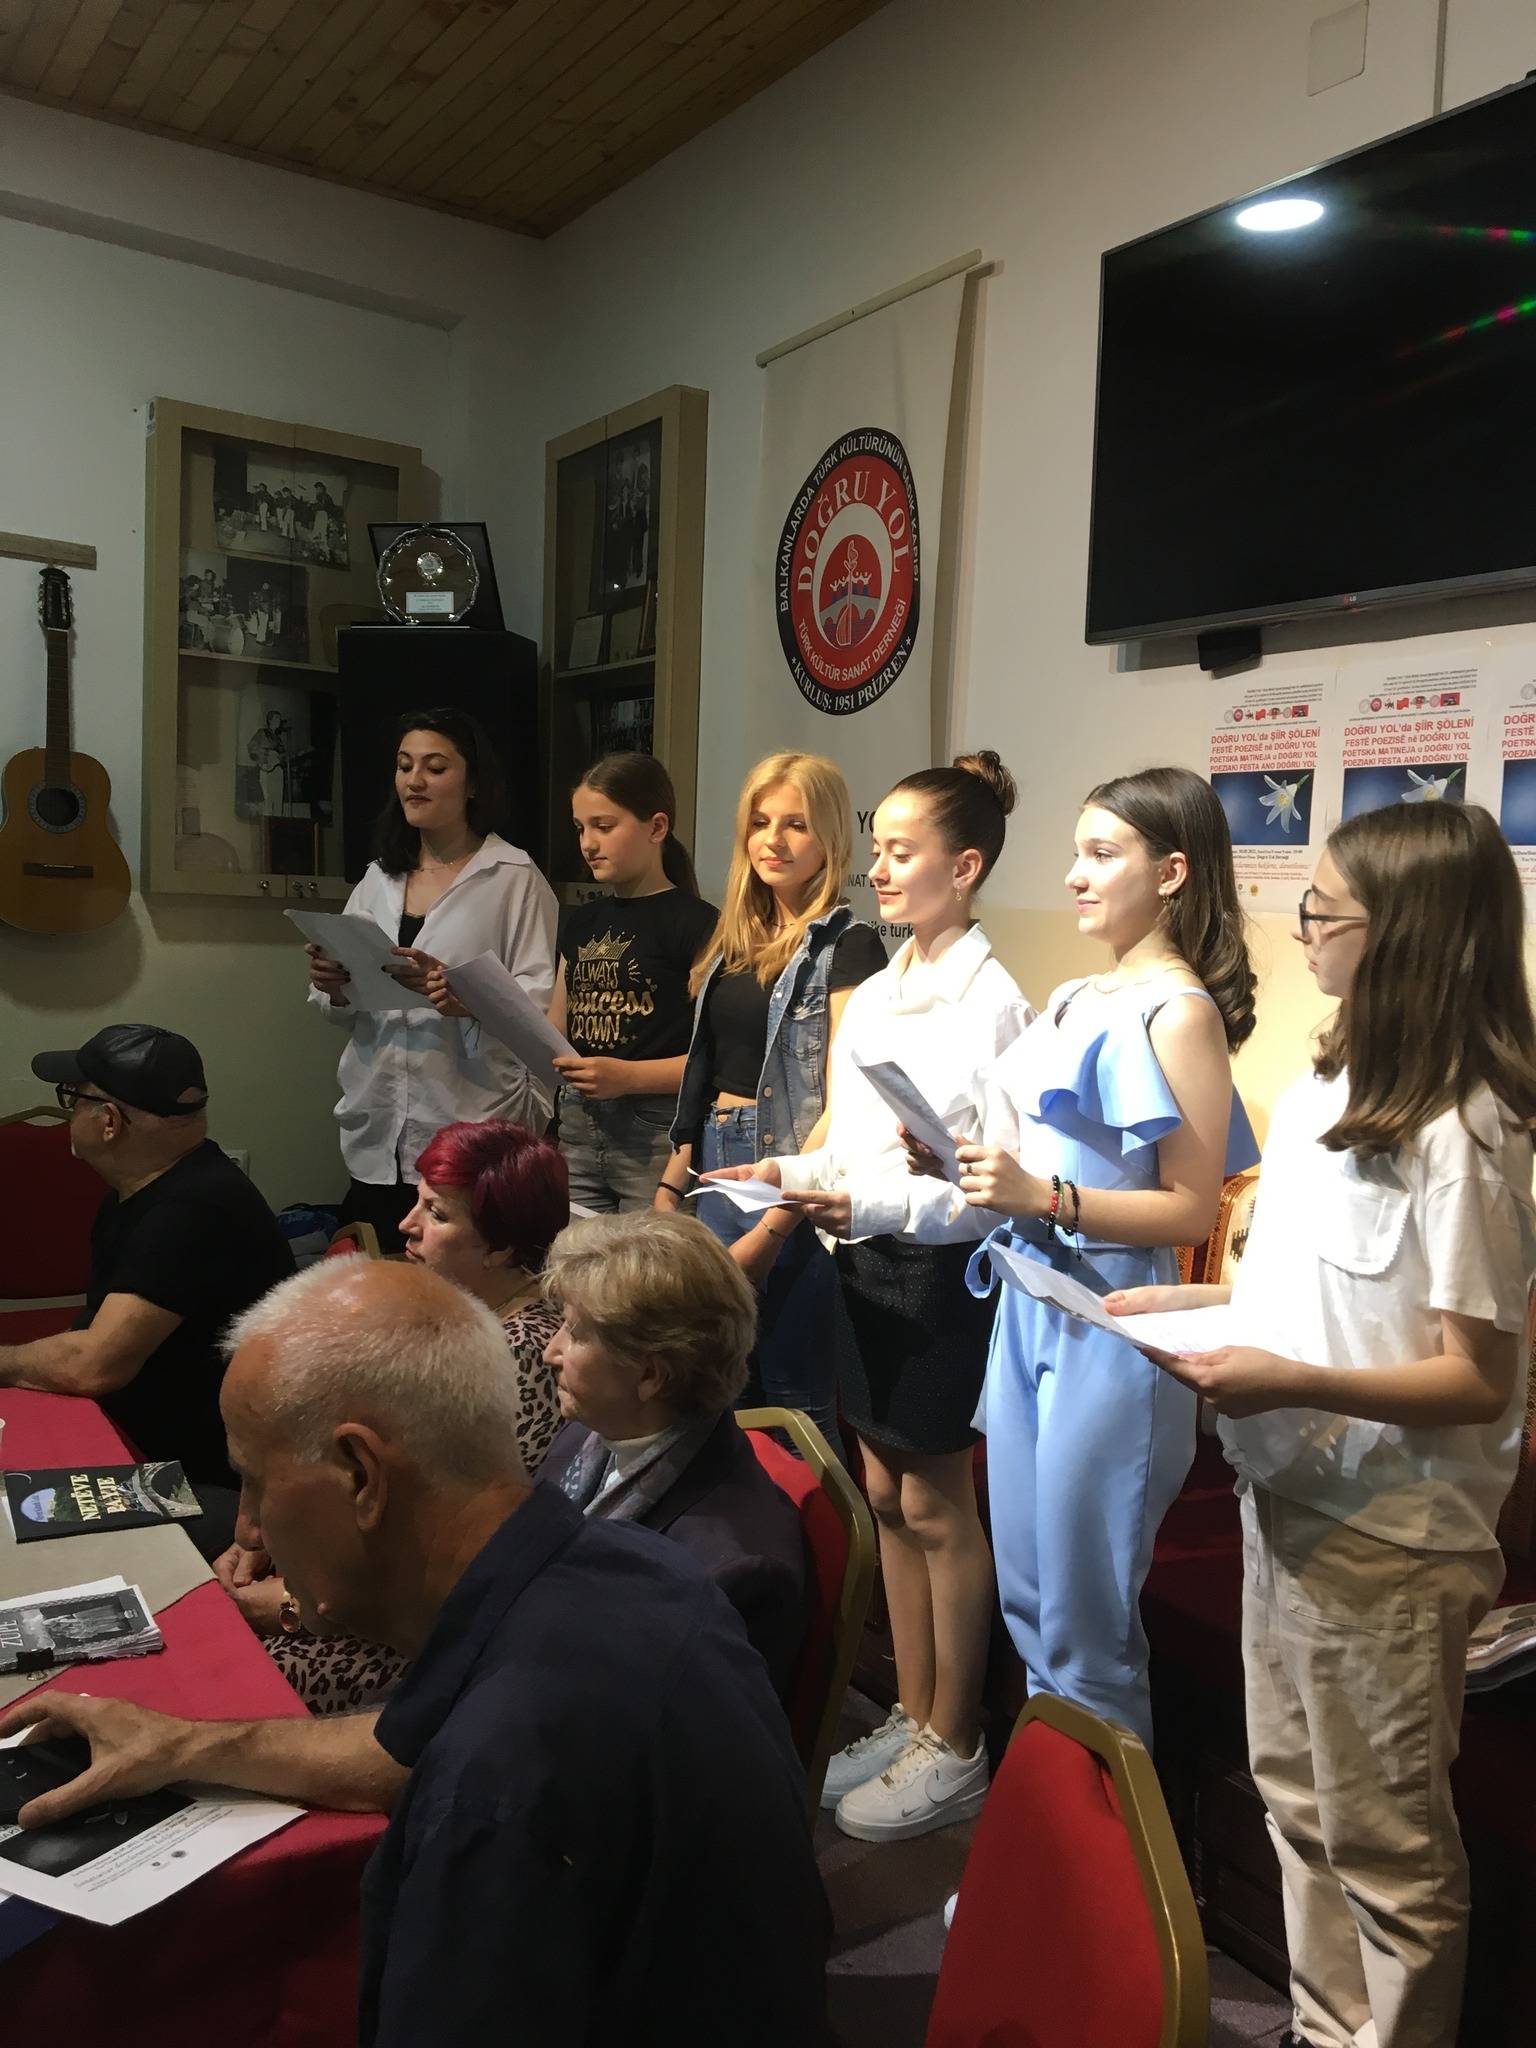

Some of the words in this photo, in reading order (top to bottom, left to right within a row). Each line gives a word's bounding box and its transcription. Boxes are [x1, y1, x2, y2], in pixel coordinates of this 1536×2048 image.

[780, 487, 815, 612] BALKANLARDA
[813, 450, 838, 486] TÜRK
[839, 432, 904, 470] KÜLTÜRÜNÜN
[797, 471, 871, 592] DOĞRU
[875, 478, 909, 573] YOL
[799, 618, 814, 656] TÜRK
[810, 655, 840, 681] KÜLTÜR
[841, 655, 871, 681] SANAT
[872, 598, 907, 662] DERNEĞİ
[835, 694, 855, 711] 1951
[857, 645, 908, 706] PRİZREN
[1344, 725, 1377, 736] DOĞRU
[1380, 723, 1411, 733] YOL'da
[1505, 726, 1535, 737] FESTË
[1211, 734, 1239, 744] DOĞRU
[1241, 732, 1268, 742] YOL'da
[1420, 732, 1451, 743] DOĞRU
[1453, 731, 1470, 740] YOL
[1274, 741, 1300, 751] DOĞRU
[1302, 741, 1317, 749] YOL
[1342, 748, 1376, 758] POETSKA
[1378, 746, 1416, 755] MATINEJA
[1424, 743, 1453, 753] DOĞRU
[1456, 742, 1471, 750] YOL
[1210, 755, 1238, 765] POETSKA
[1240, 753, 1271, 762] MATINEJA
[1278, 751, 1302, 760] DOĞRU
[1304, 751, 1318, 759] YOL
[1378, 756, 1402, 765] FESTA
[1403, 755, 1420, 764] ANO
[1423, 753, 1451, 762] DOĞRU
[1453, 752, 1470, 761] YOL
[1240, 763, 1259, 771] FESTA
[1261, 762, 1275, 770] ANO
[1277, 760, 1300, 769] DOĞRU
[1302, 760, 1316, 768] YOL
[573, 961, 619, 990] ALWAYS
[70, 1473, 101, 1522] NETËVE
